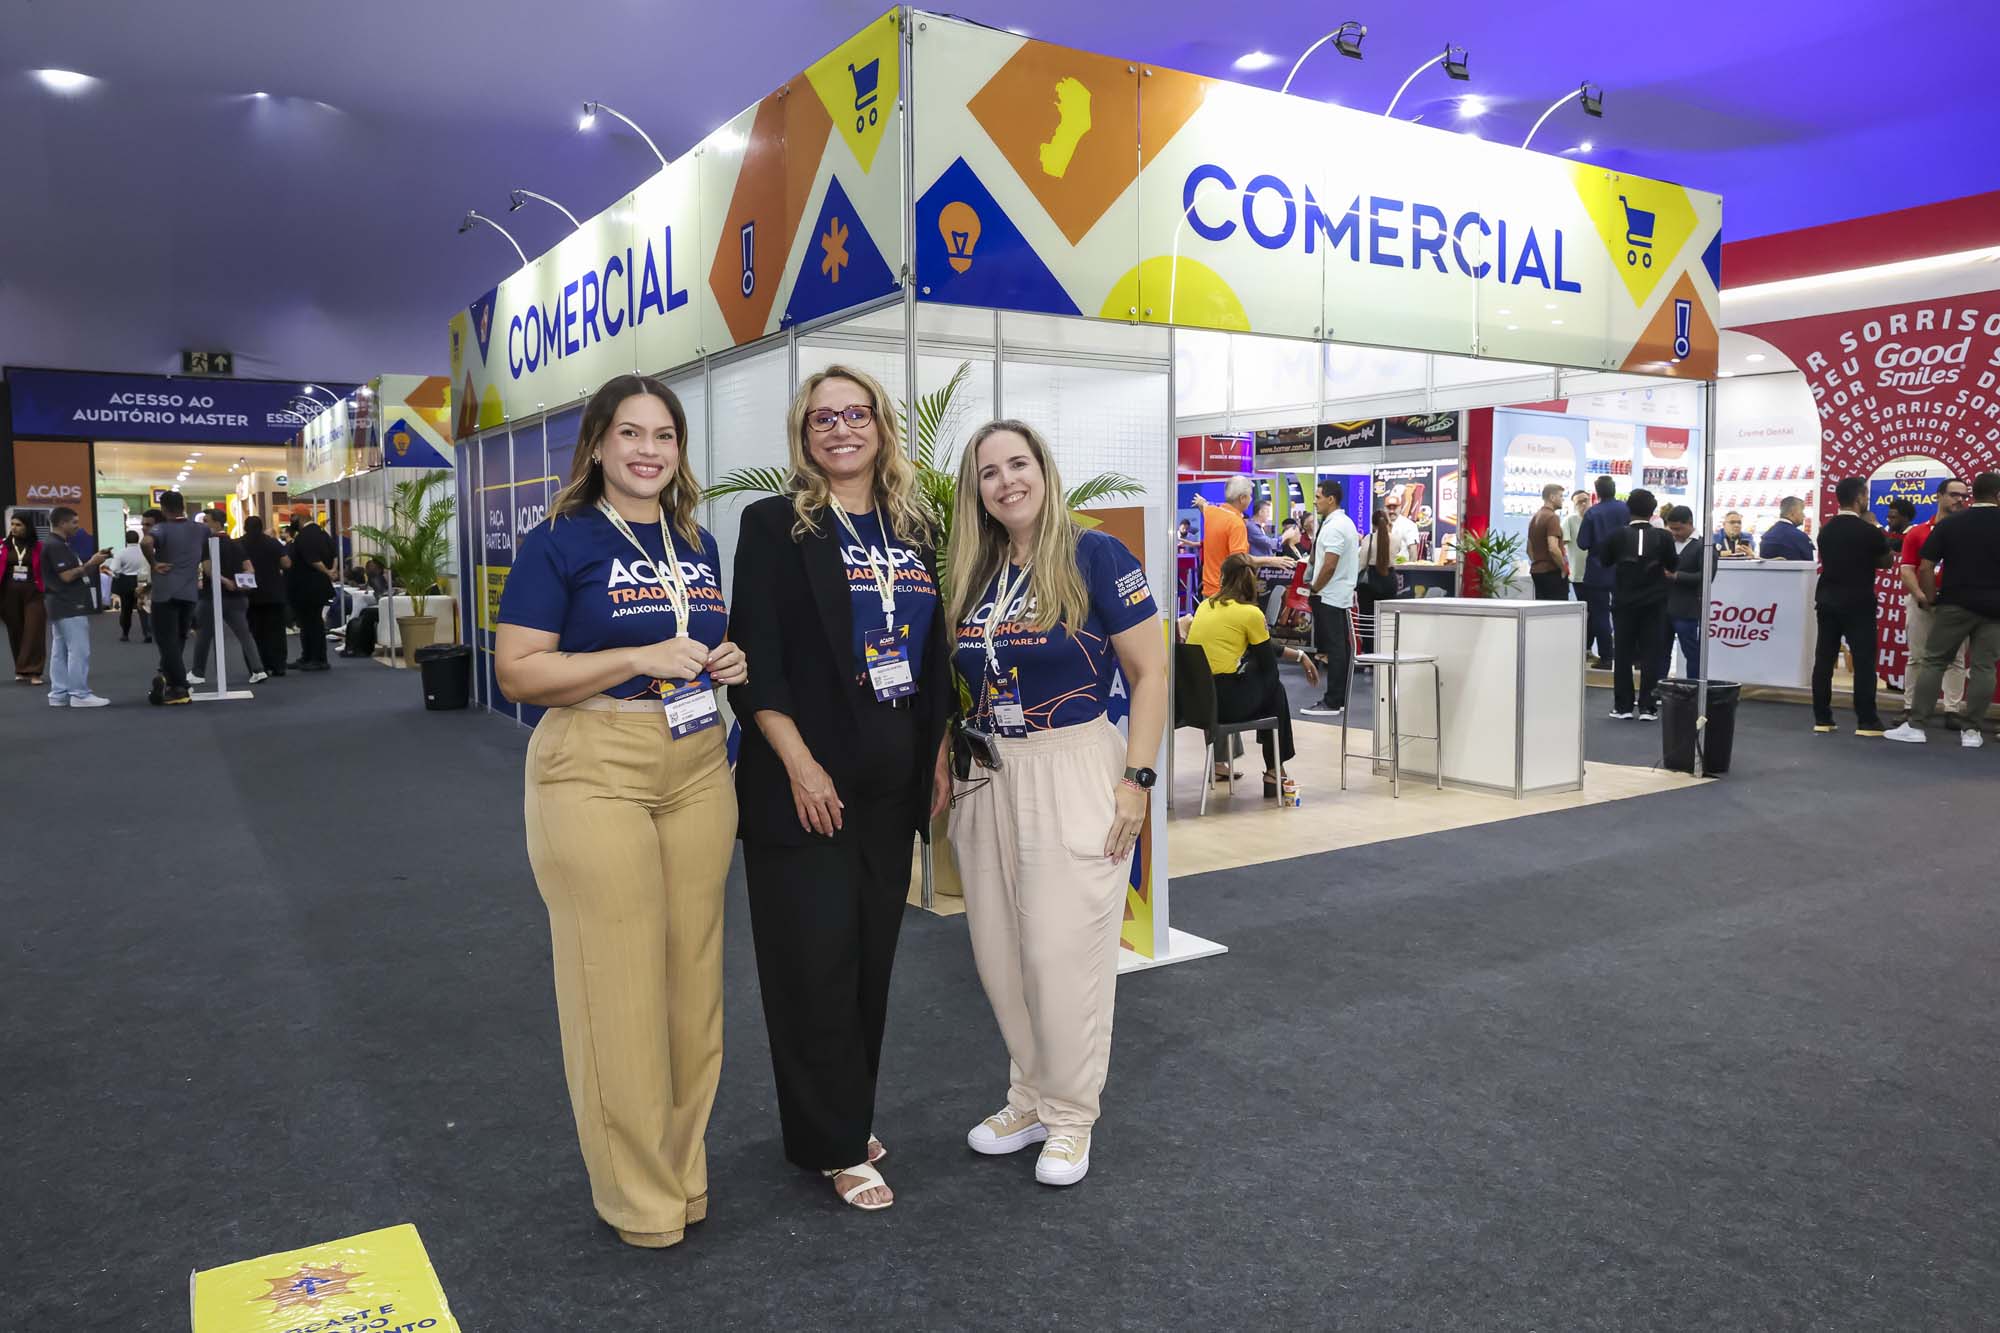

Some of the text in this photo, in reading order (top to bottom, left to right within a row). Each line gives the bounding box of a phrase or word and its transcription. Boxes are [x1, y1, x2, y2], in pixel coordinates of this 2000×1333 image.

[1183, 164, 1582, 293] COMERCIAL
[509, 225, 689, 379] COMERCIAL
[1874, 336, 1972, 368] Good
[1876, 366, 1961, 387] Smiles
[109, 392, 214, 409] ACESSO AO
[72, 408, 249, 426] AUDITÓRIO MASTER
[1838, 395, 1877, 427] SEU
[1869, 400, 1967, 424] SORRISO!
[1847, 431, 1875, 457] SEU
[1880, 417, 1951, 434] MELHOR
[1888, 444, 1938, 456] MELHOR
[1895, 469, 1928, 479] Good
[26, 485, 82, 498] ACAPS
[485, 532, 511, 550] PARTE DA
[608, 557, 717, 588] ACAPS
[1709, 601, 1778, 625] Good
[1010, 637, 1048, 646] VAREJO
[1708, 624, 1771, 641] Smiles
[379, 1303, 396, 1315] E
